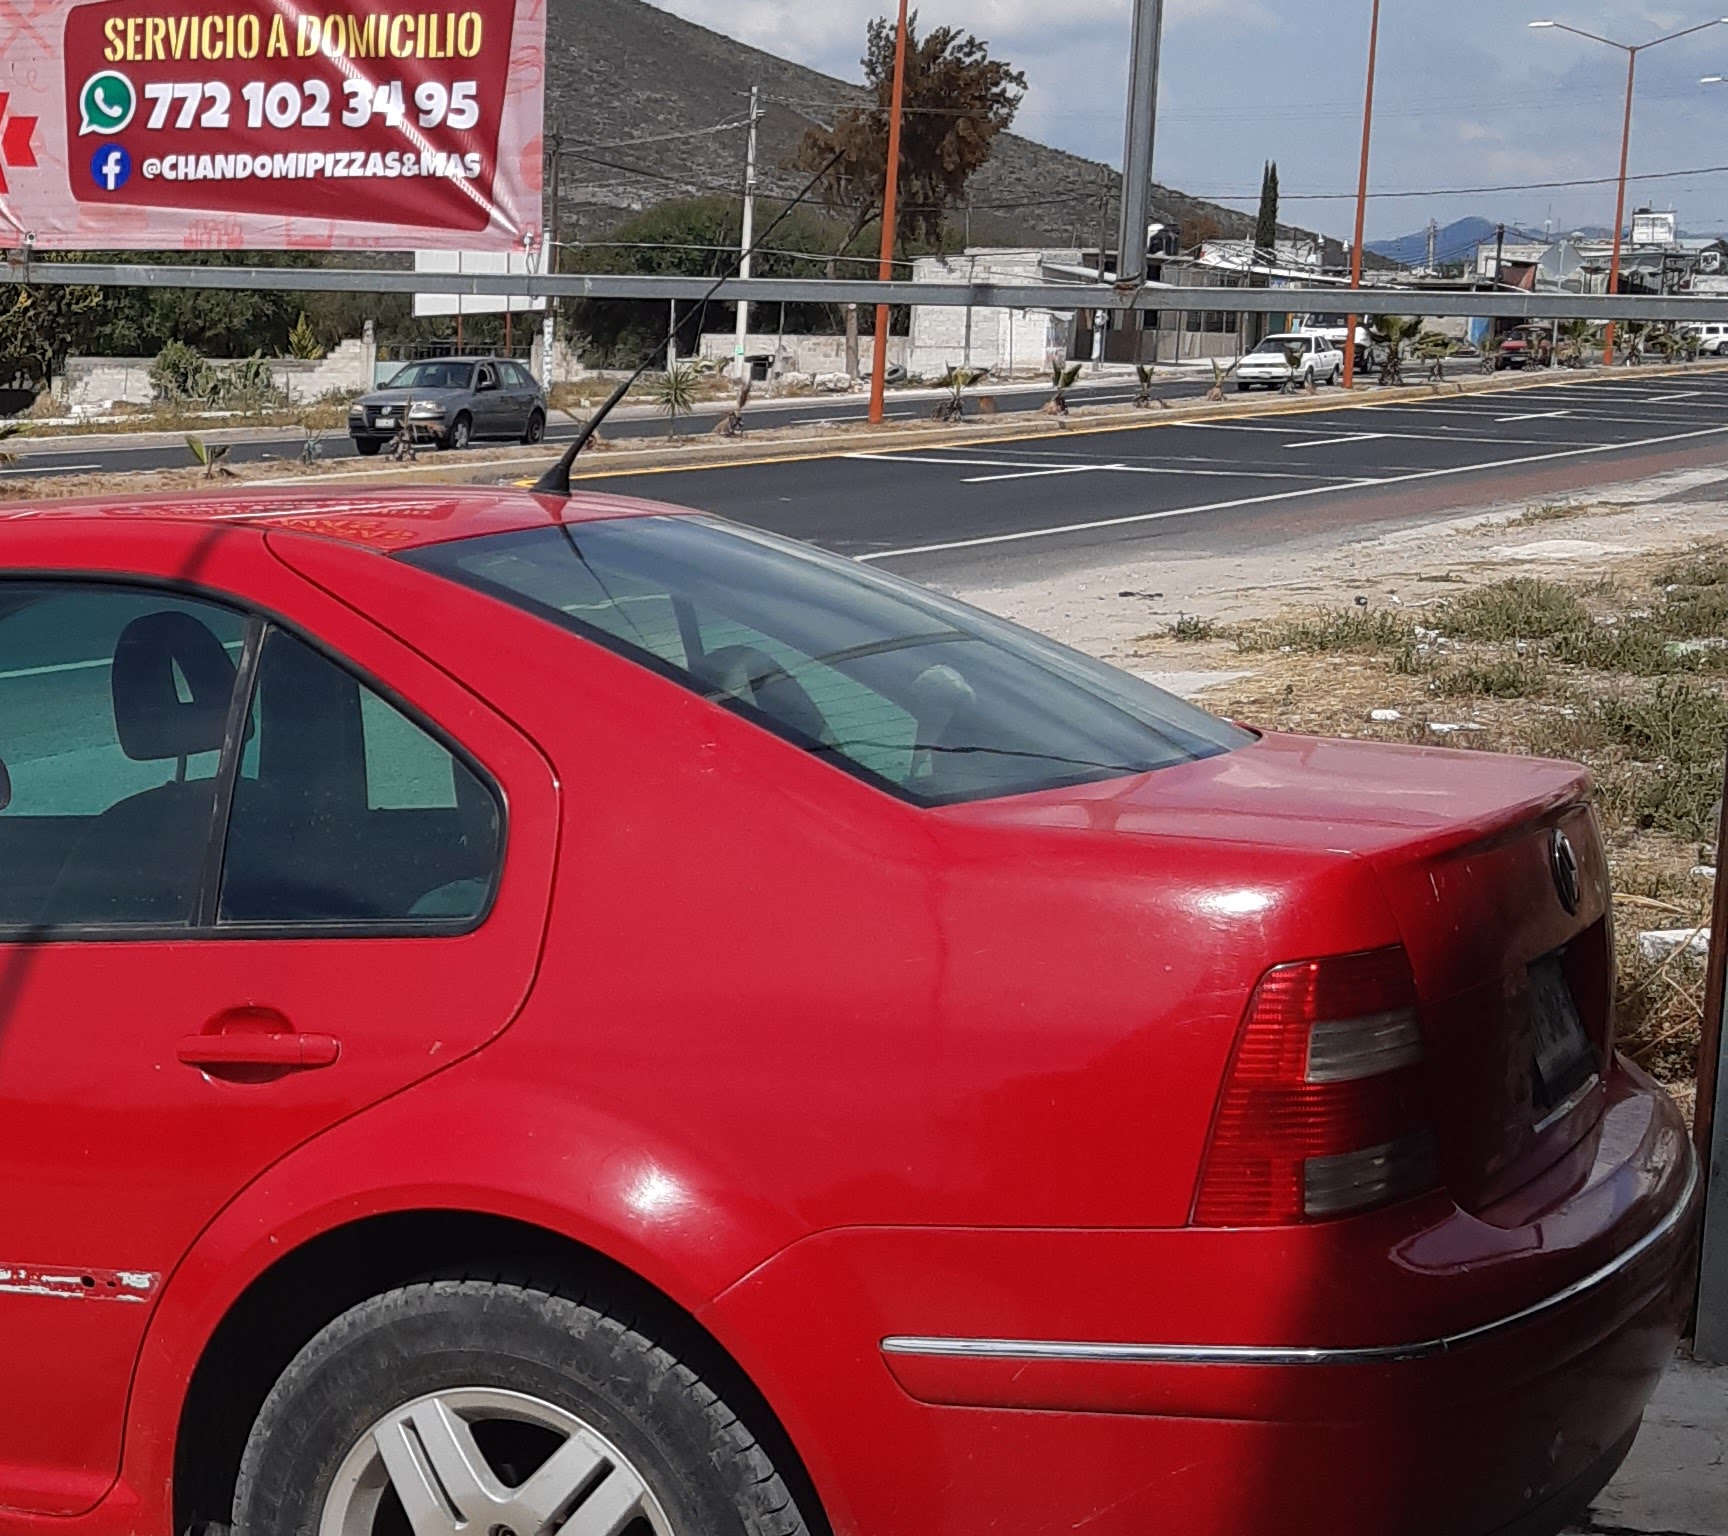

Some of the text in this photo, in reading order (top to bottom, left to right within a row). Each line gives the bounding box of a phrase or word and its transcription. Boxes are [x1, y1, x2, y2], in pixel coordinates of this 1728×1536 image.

[103, 11, 482, 61] SERVICIO A DOMICILIO
[144, 78, 480, 129] 772 102 34 95
[142, 151, 482, 181] @CHANDOMIPIZZAS&MAS
